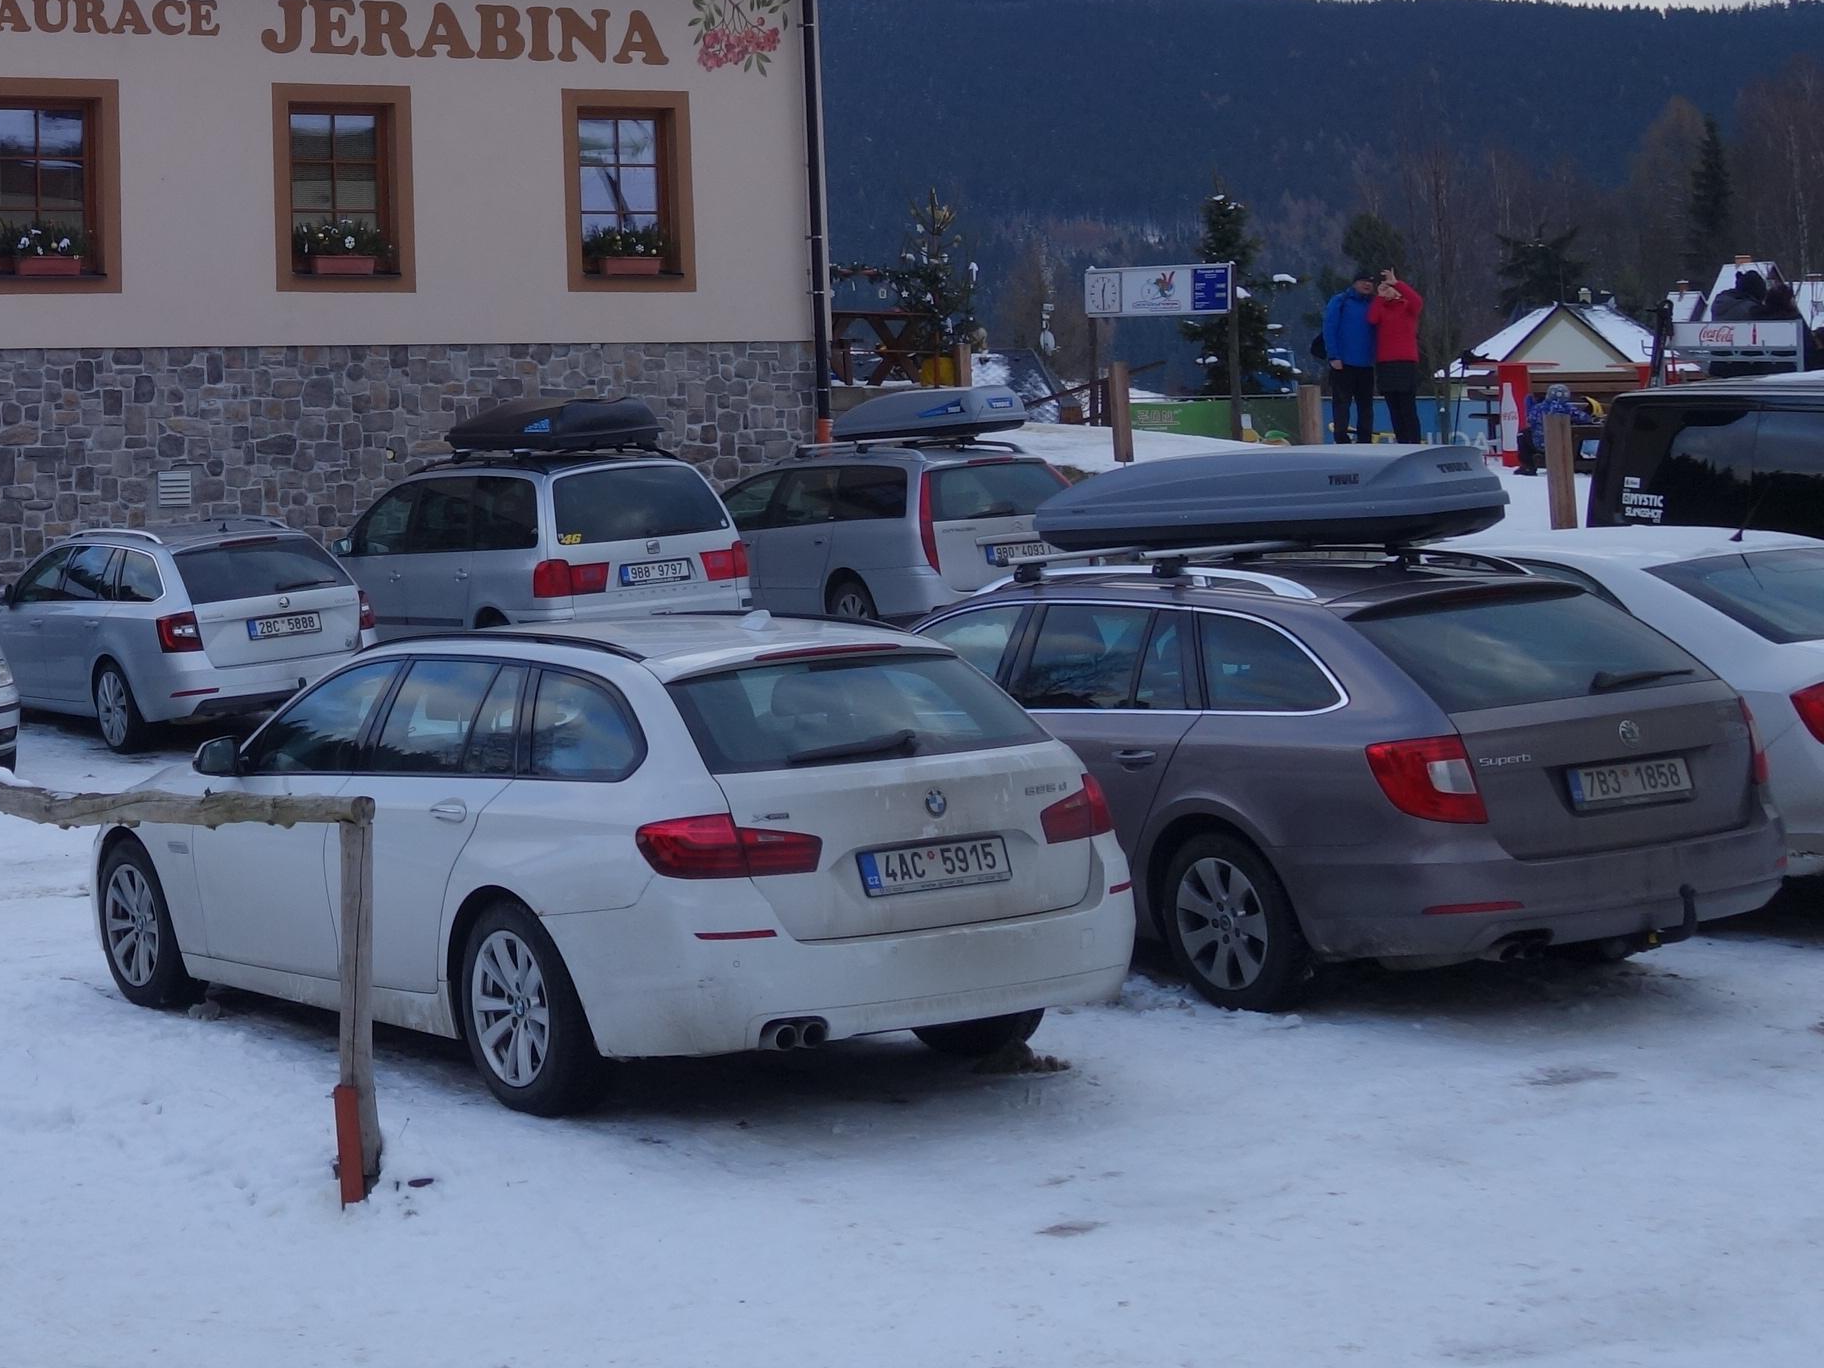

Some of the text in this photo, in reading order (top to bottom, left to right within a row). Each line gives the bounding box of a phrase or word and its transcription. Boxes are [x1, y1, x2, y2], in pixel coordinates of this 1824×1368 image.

[1328, 474, 1359, 485] THULE
[631, 563, 682, 579] 9B8 9797
[259, 620, 280, 634] 2BC
[1479, 754, 1531, 767] Superb
[1584, 763, 1681, 798] 7B3 1858
[885, 833, 996, 881] 4AC 5915
